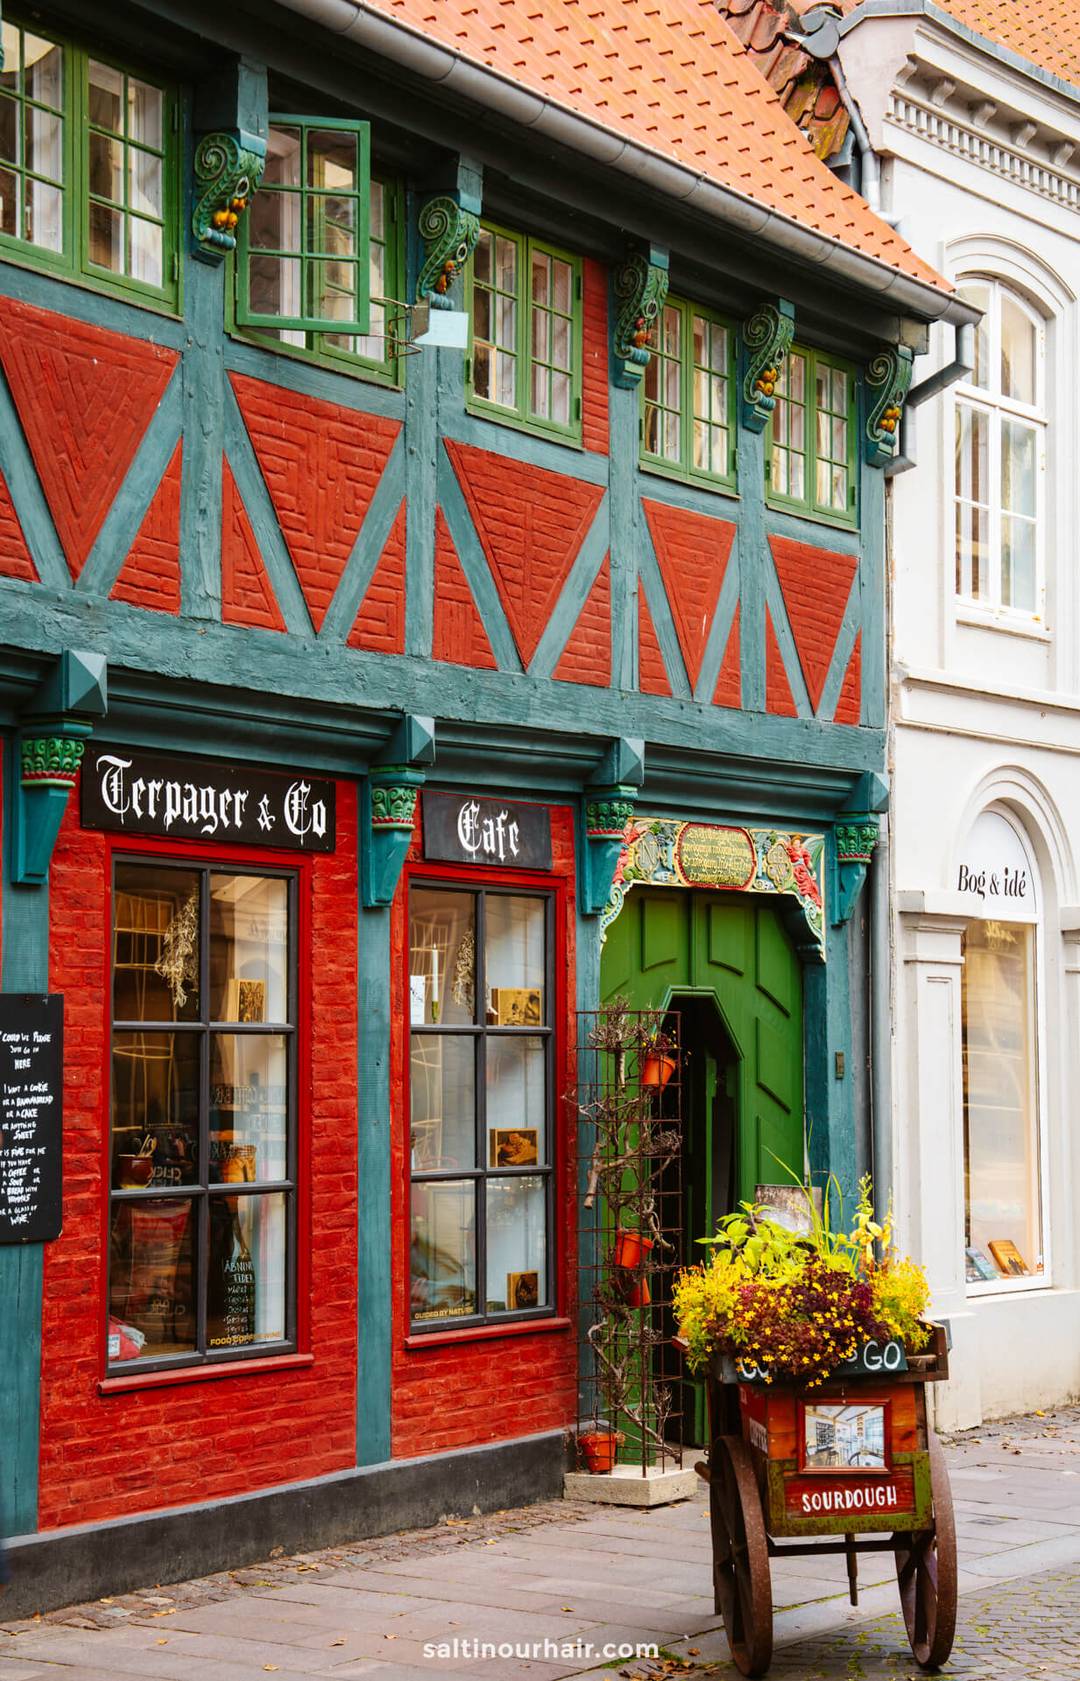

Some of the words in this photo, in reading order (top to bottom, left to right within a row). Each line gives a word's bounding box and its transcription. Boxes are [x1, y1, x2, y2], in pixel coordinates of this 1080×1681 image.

[96, 754, 249, 834] Terpager
[257, 793, 276, 832] &
[284, 780, 327, 845] Co
[457, 800, 519, 862] Cafe
[958, 865, 985, 900] Bog
[989, 872, 999, 896] &
[1004, 866, 1026, 898] idé
[4, 1083, 6, 1093] I
[863, 1340, 901, 1371] GO
[802, 1485, 897, 1513] SOURDOUGH
